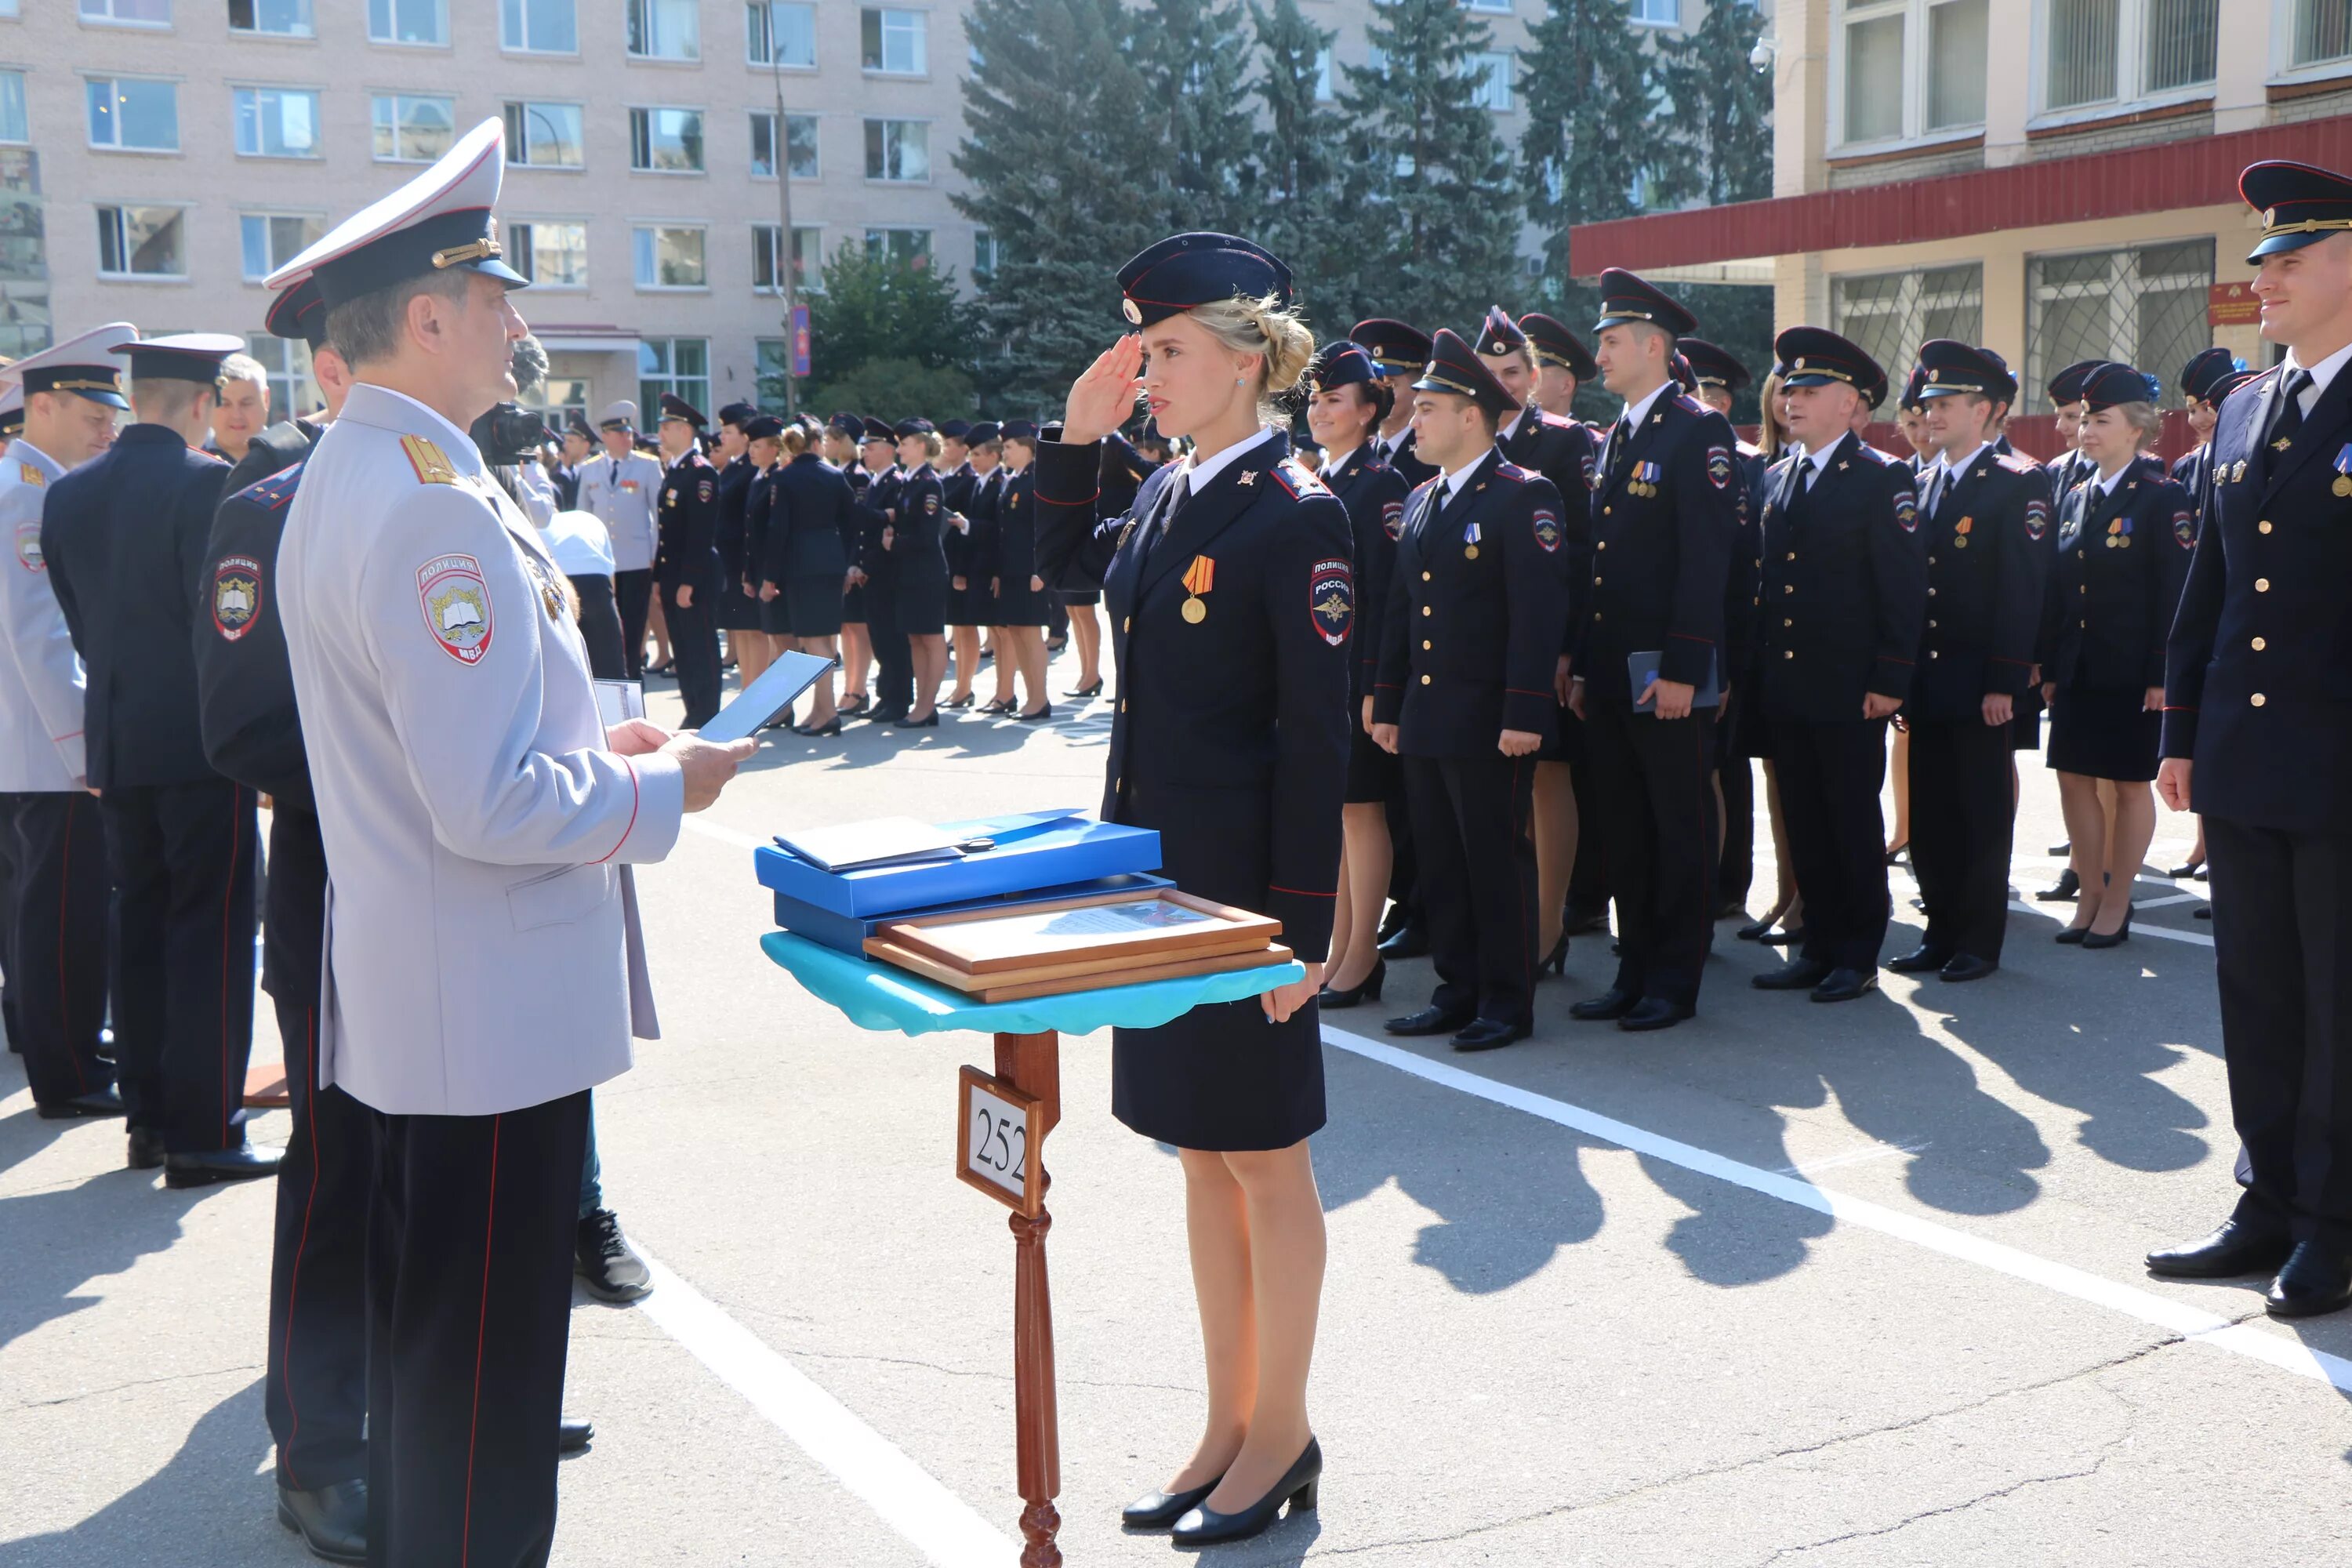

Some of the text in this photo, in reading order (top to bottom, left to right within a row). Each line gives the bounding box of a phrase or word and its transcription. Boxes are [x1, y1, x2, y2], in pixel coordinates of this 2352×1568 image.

[422, 559, 474, 583] ПОЛИЦИЯ
[1315, 561, 1349, 573] ПОЛИЦИЯ
[1316, 580, 1349, 595] РОССИЯ
[1326, 633, 1343, 646] МВД
[458, 644, 482, 660] МВД
[977, 1108, 1026, 1183] 252
